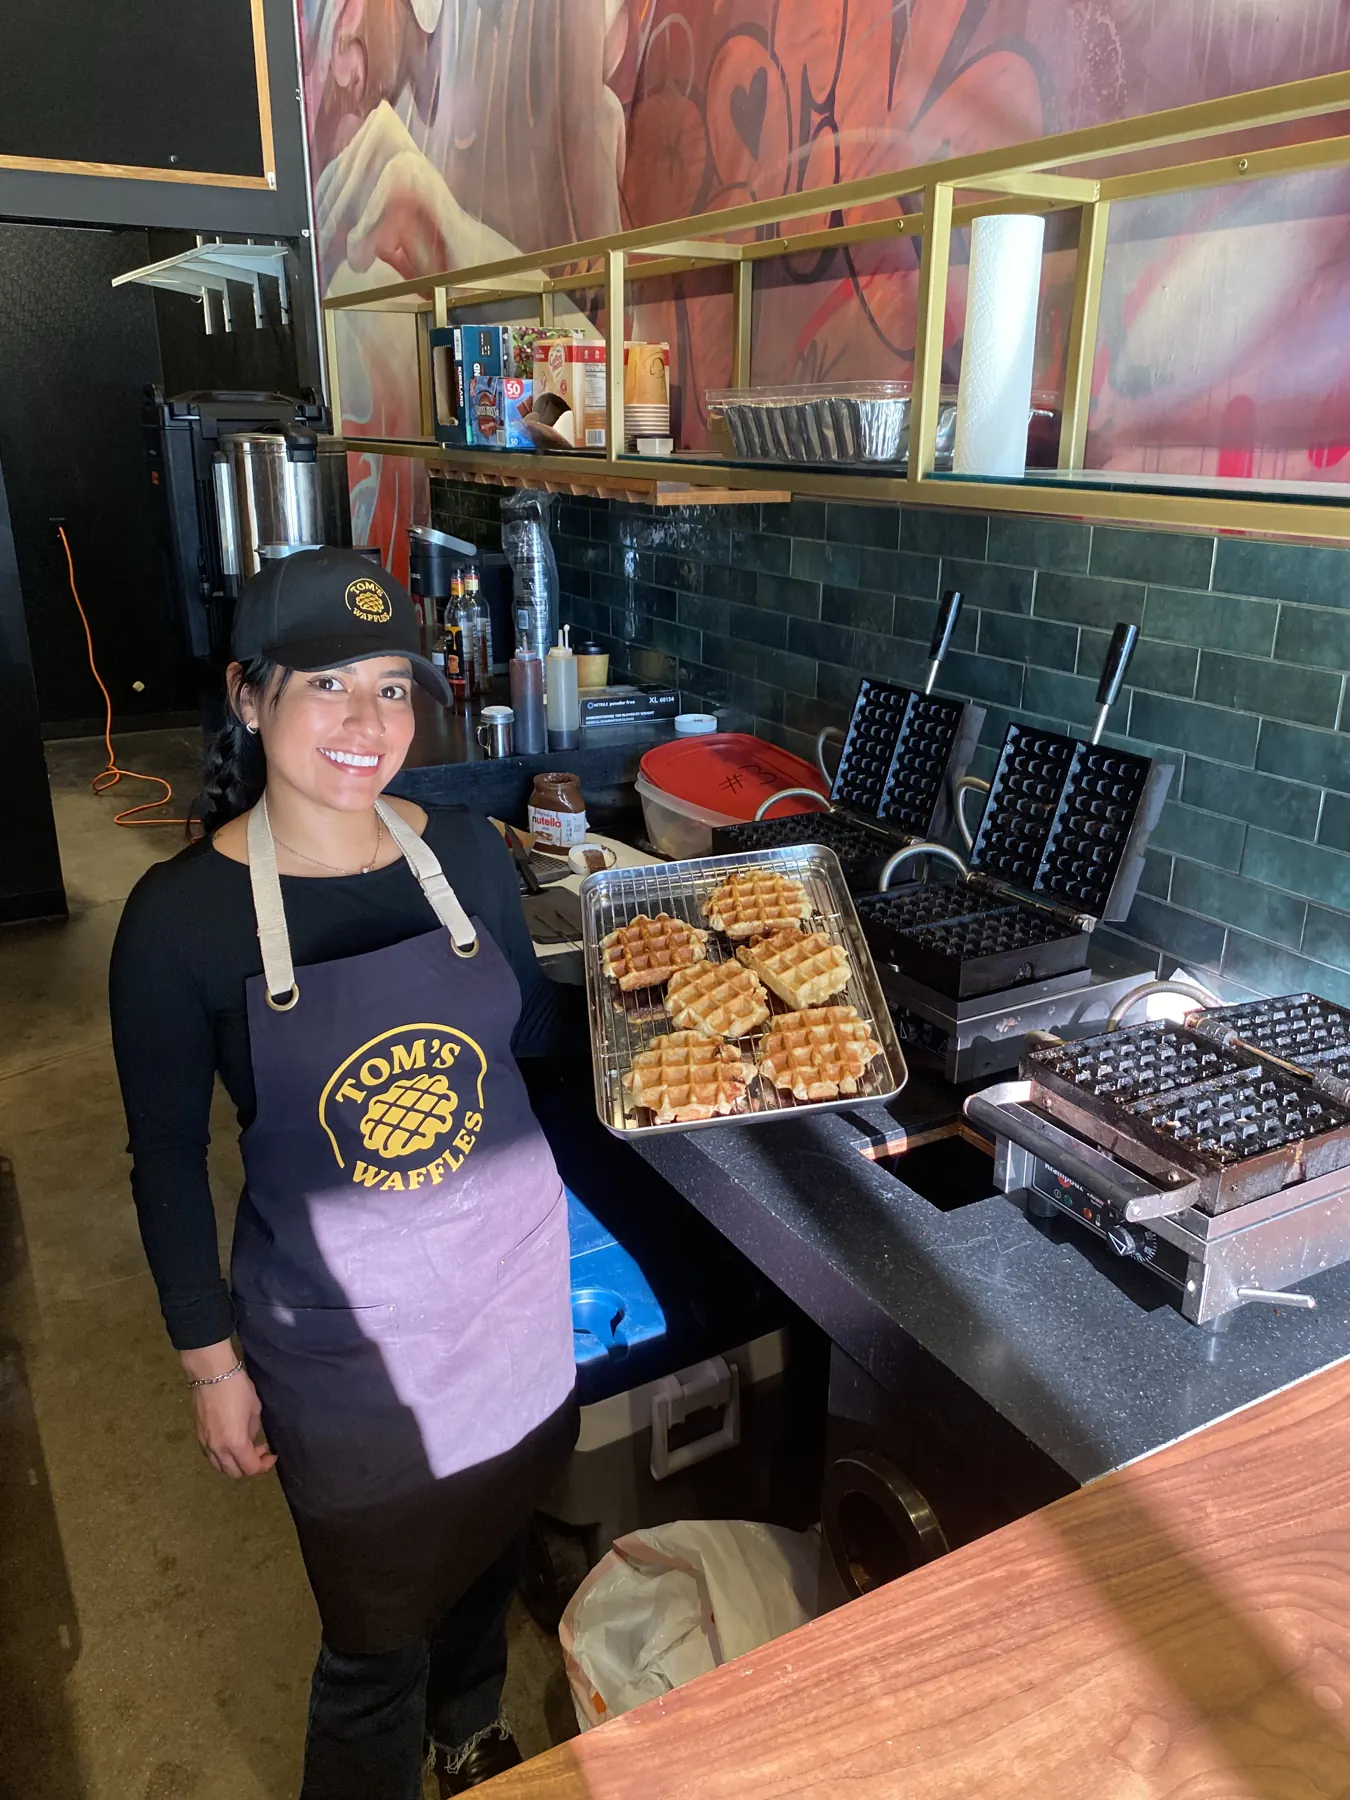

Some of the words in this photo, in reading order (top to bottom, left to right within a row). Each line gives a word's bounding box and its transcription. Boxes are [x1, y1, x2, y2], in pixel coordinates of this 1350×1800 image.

[507, 384, 521, 395] 50
[510, 437, 519, 446] 50
[350, 581, 384, 597] TOM'S
[353, 607, 390, 623] WAFFLES
[648, 696, 659, 704] XL
[532, 815, 562, 829] nutella
[335, 1038, 461, 1104] TOM'S
[352, 1111, 483, 1191] WAFFLES
